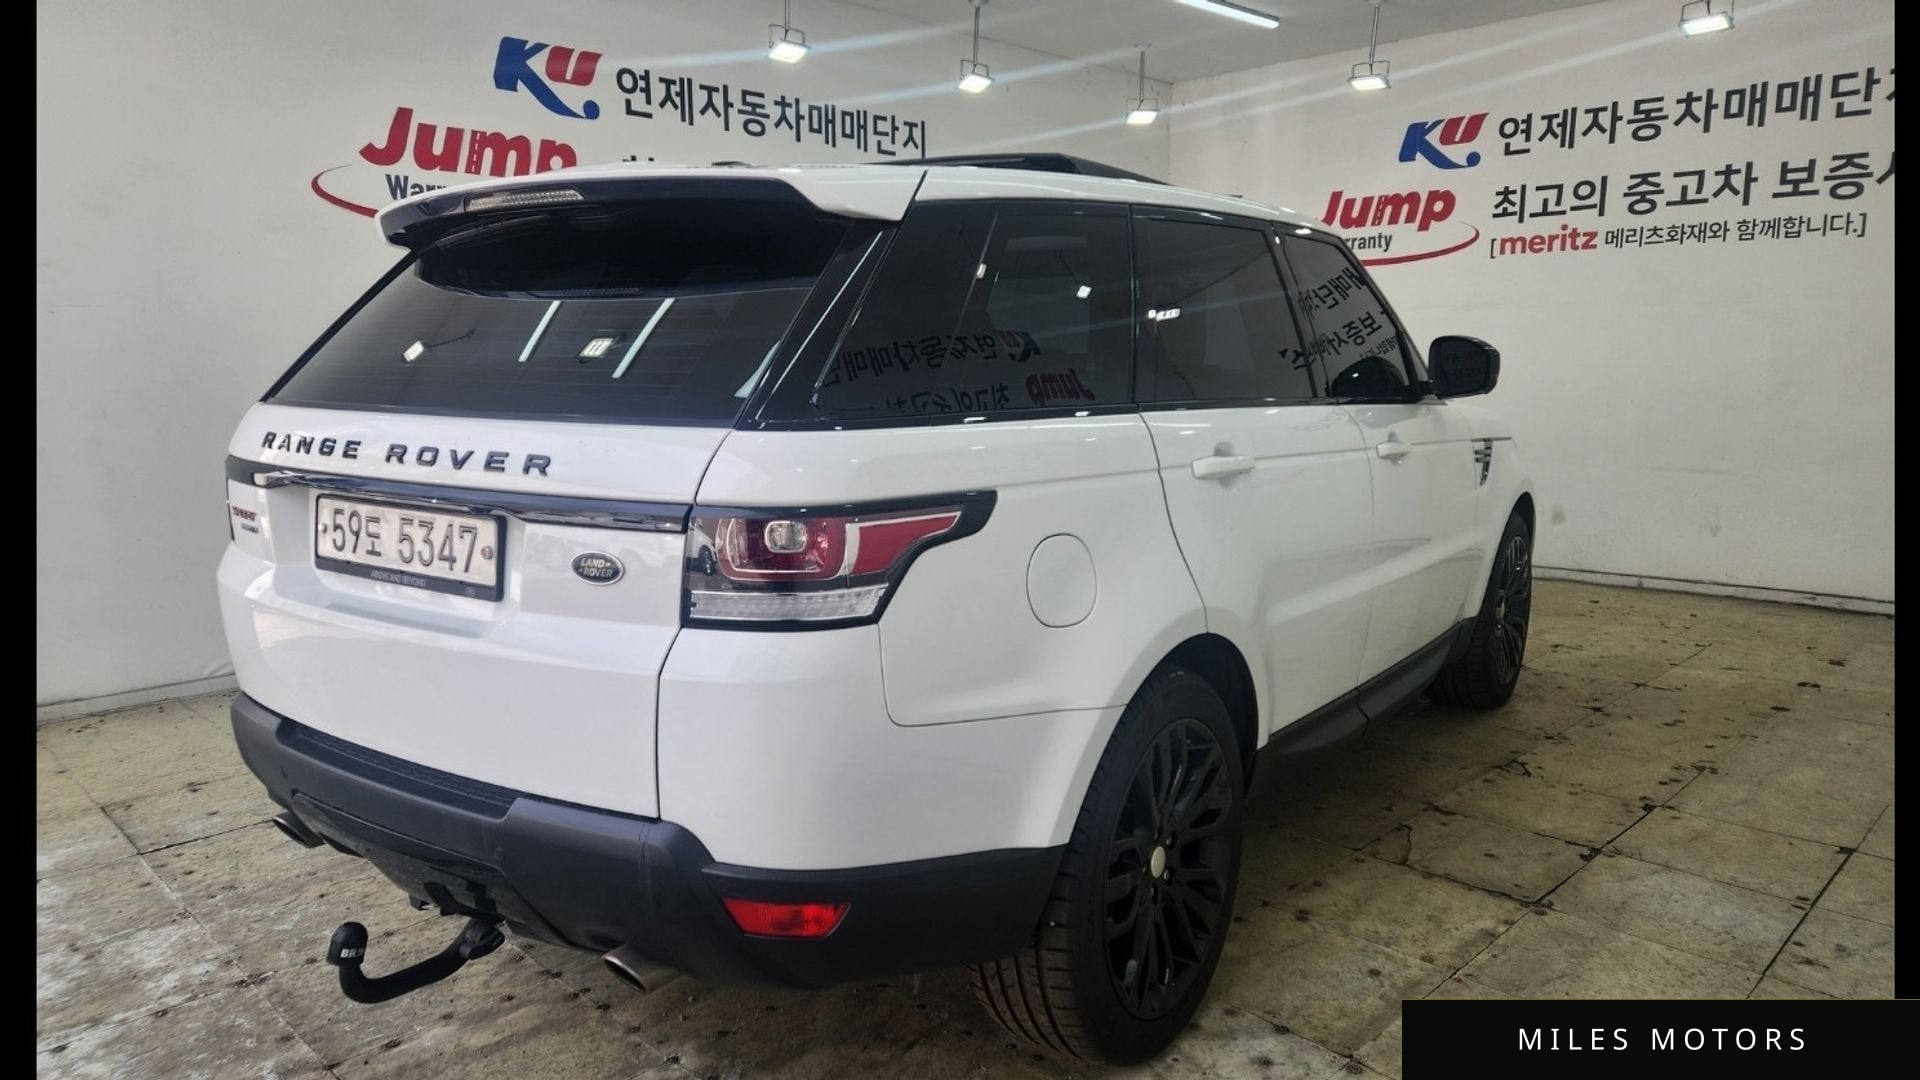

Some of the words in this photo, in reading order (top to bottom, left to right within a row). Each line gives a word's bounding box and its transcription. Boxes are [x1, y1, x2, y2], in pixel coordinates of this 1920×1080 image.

[615, 66, 927, 158] 연제자동차매매단지
[1322, 189, 1456, 232] Jump
[1492, 174, 1608, 223] 최고의
[1622, 160, 1759, 215] 중고차
[1604, 220, 1730, 250] 메리츠화재와
[1736, 212, 1868, 242] 함께합니다.]
[262, 431, 361, 460] RANGE
[385, 444, 553, 476] ROVER
[332, 508, 382, 557] 59도
[399, 517, 478, 573] 5347
[580, 557, 605, 568] LAND
[583, 567, 613, 578] ROVER
